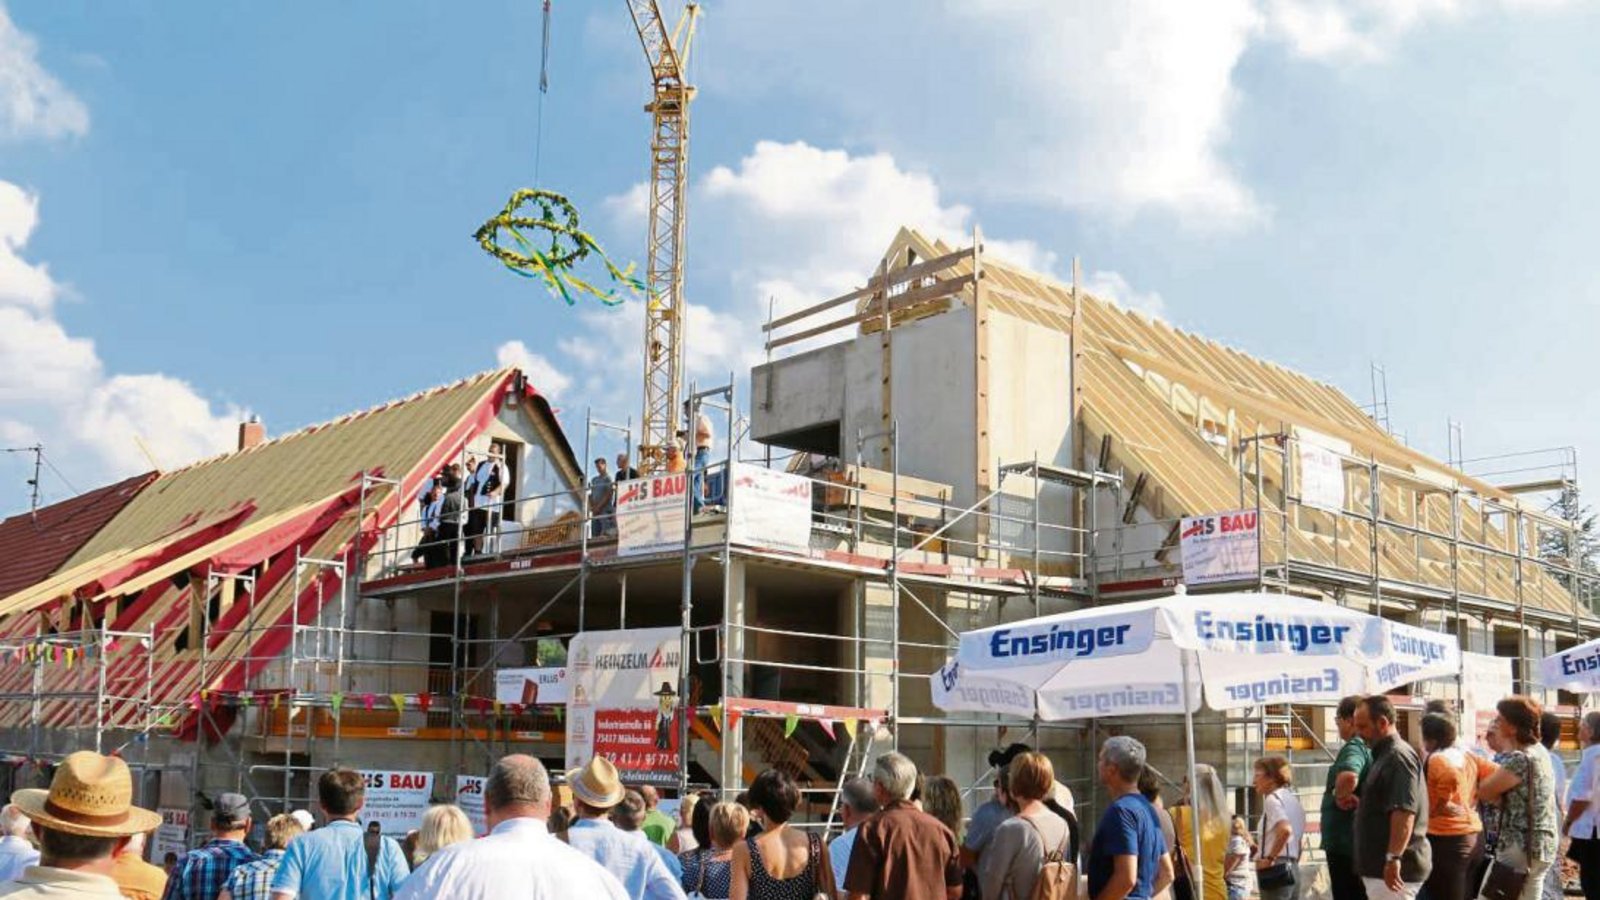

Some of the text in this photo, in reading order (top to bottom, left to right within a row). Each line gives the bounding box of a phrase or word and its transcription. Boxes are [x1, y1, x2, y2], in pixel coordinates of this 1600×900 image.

[652, 475, 686, 497] BAU
[1220, 512, 1257, 533] BAU
[990, 624, 1131, 657] Ensinger
[1195, 610, 1350, 651] Ensinger
[390, 774, 426, 789] BAU
[466, 779, 482, 794] HS
